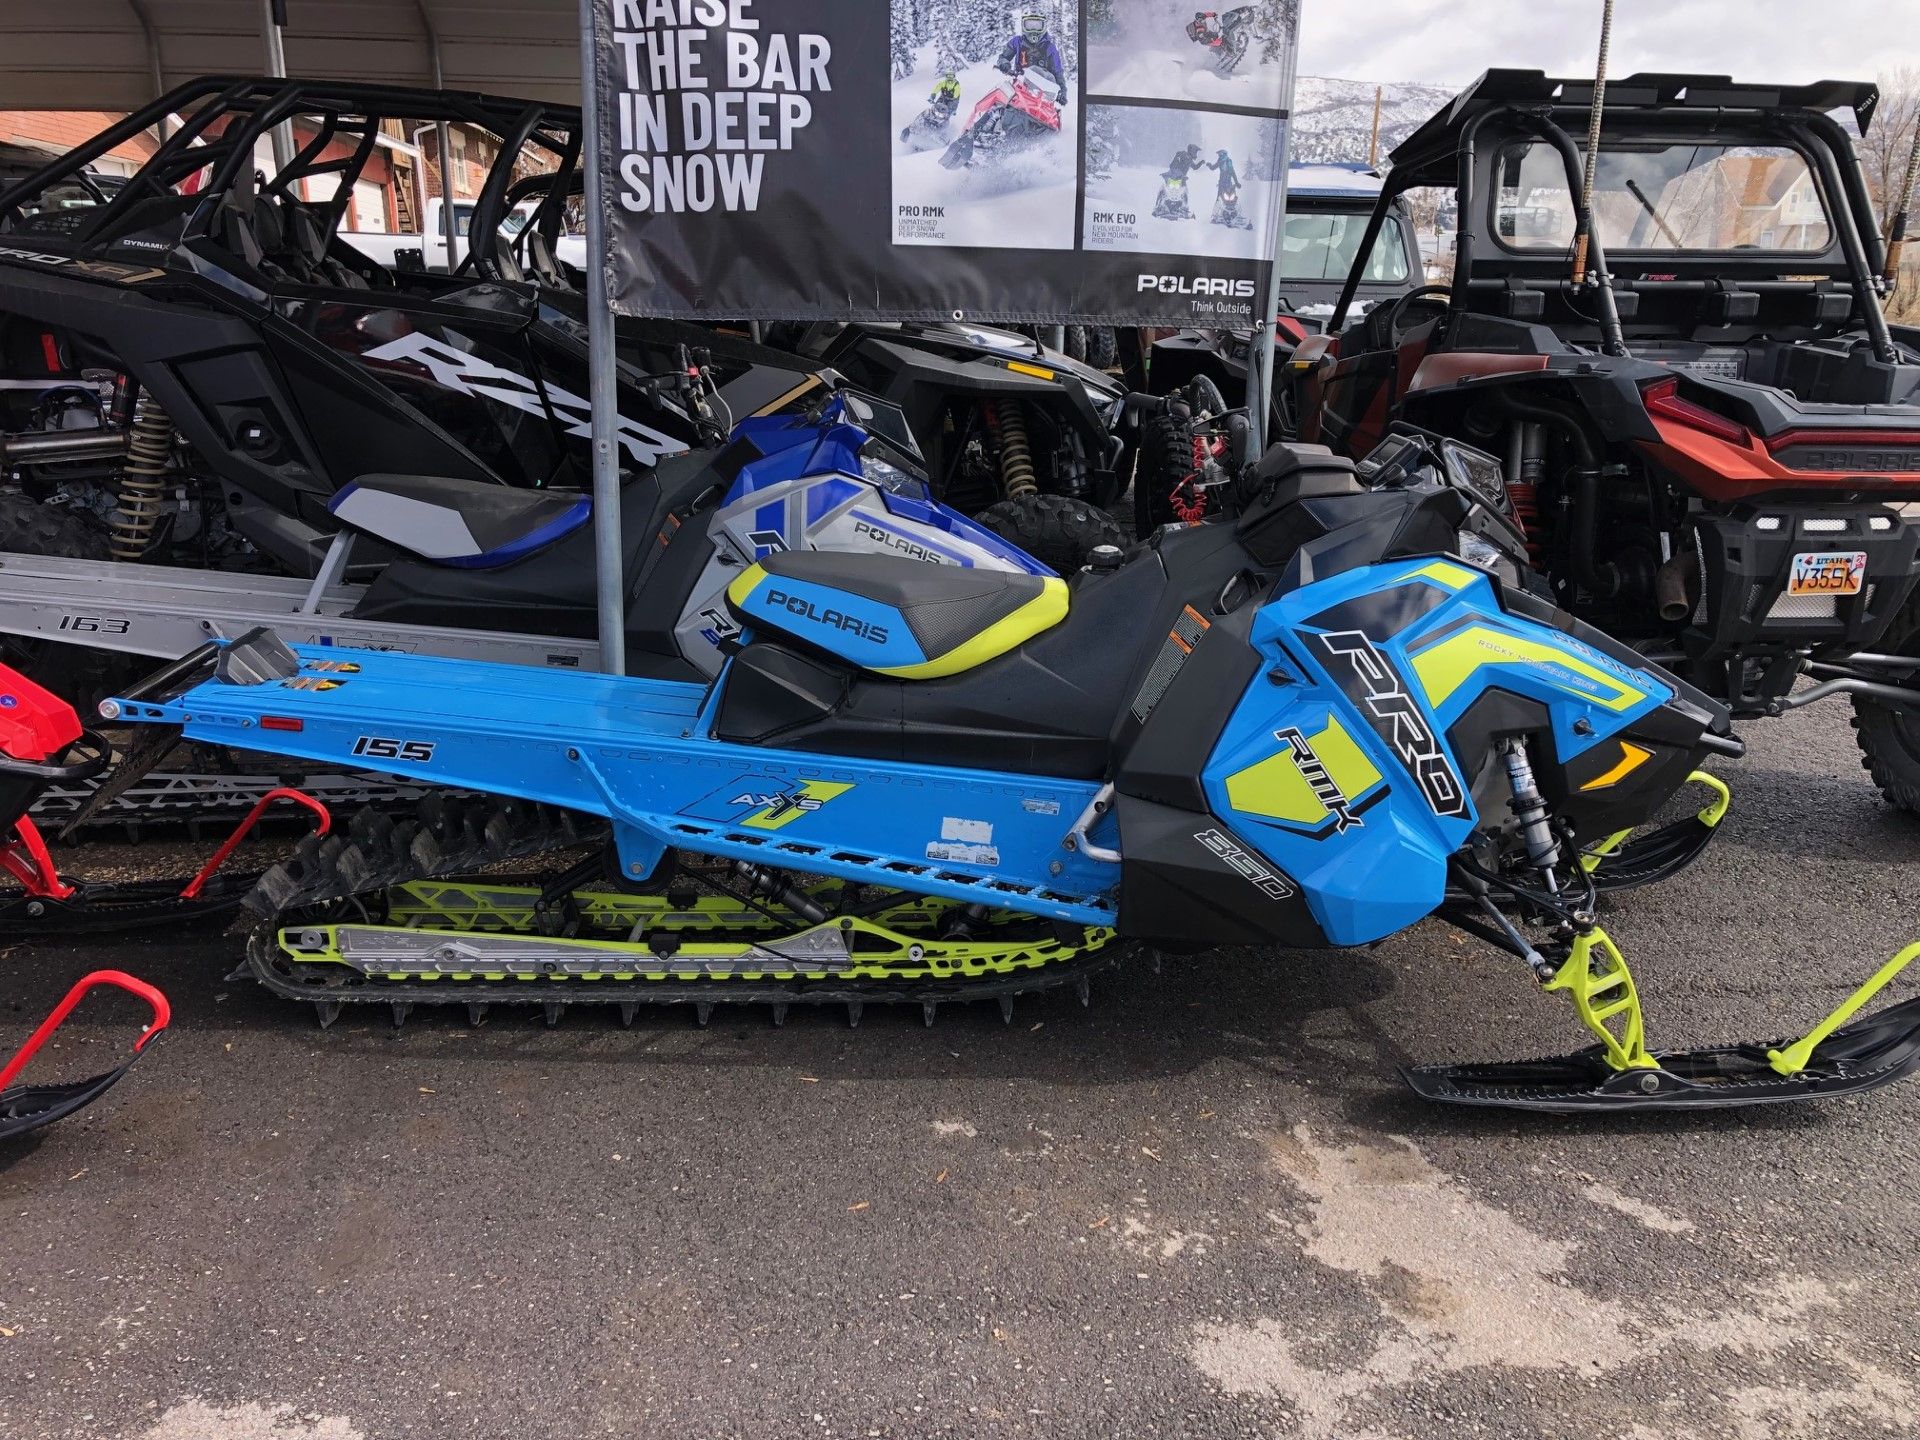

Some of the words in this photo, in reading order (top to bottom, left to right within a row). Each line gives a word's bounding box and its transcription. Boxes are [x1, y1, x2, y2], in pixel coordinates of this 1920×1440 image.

[613, 29, 708, 91] THE
[727, 31, 832, 92] BAR
[619, 92, 669, 152] IN
[681, 91, 812, 151] DEEP
[619, 153, 765, 213] SNOW
[898, 205, 920, 217] PRO
[922, 206, 945, 218] RMK
[898, 218, 938, 226] UNMATCHED
[1093, 211, 1114, 223] RMK
[1117, 213, 1136, 225] EVO
[123, 239, 170, 251] DYNAMIX
[898, 231, 945, 239] PERFORMANCE
[1137, 274, 1256, 297] POLARIS
[1191, 300, 1214, 313] Think
[1216, 301, 1252, 315] Outside
[854, 521, 942, 565] POLARIS
[1816, 557, 1844, 565] UTAH
[58, 614, 132, 634] 163
[766, 589, 889, 645] POLARIS
[1478, 639, 1514, 658] ROCKY
[1319, 630, 1465, 816] PRO
[350, 735, 437, 763] 155
[1273, 726, 1365, 835] RMK
[1193, 828, 1294, 901] 850
